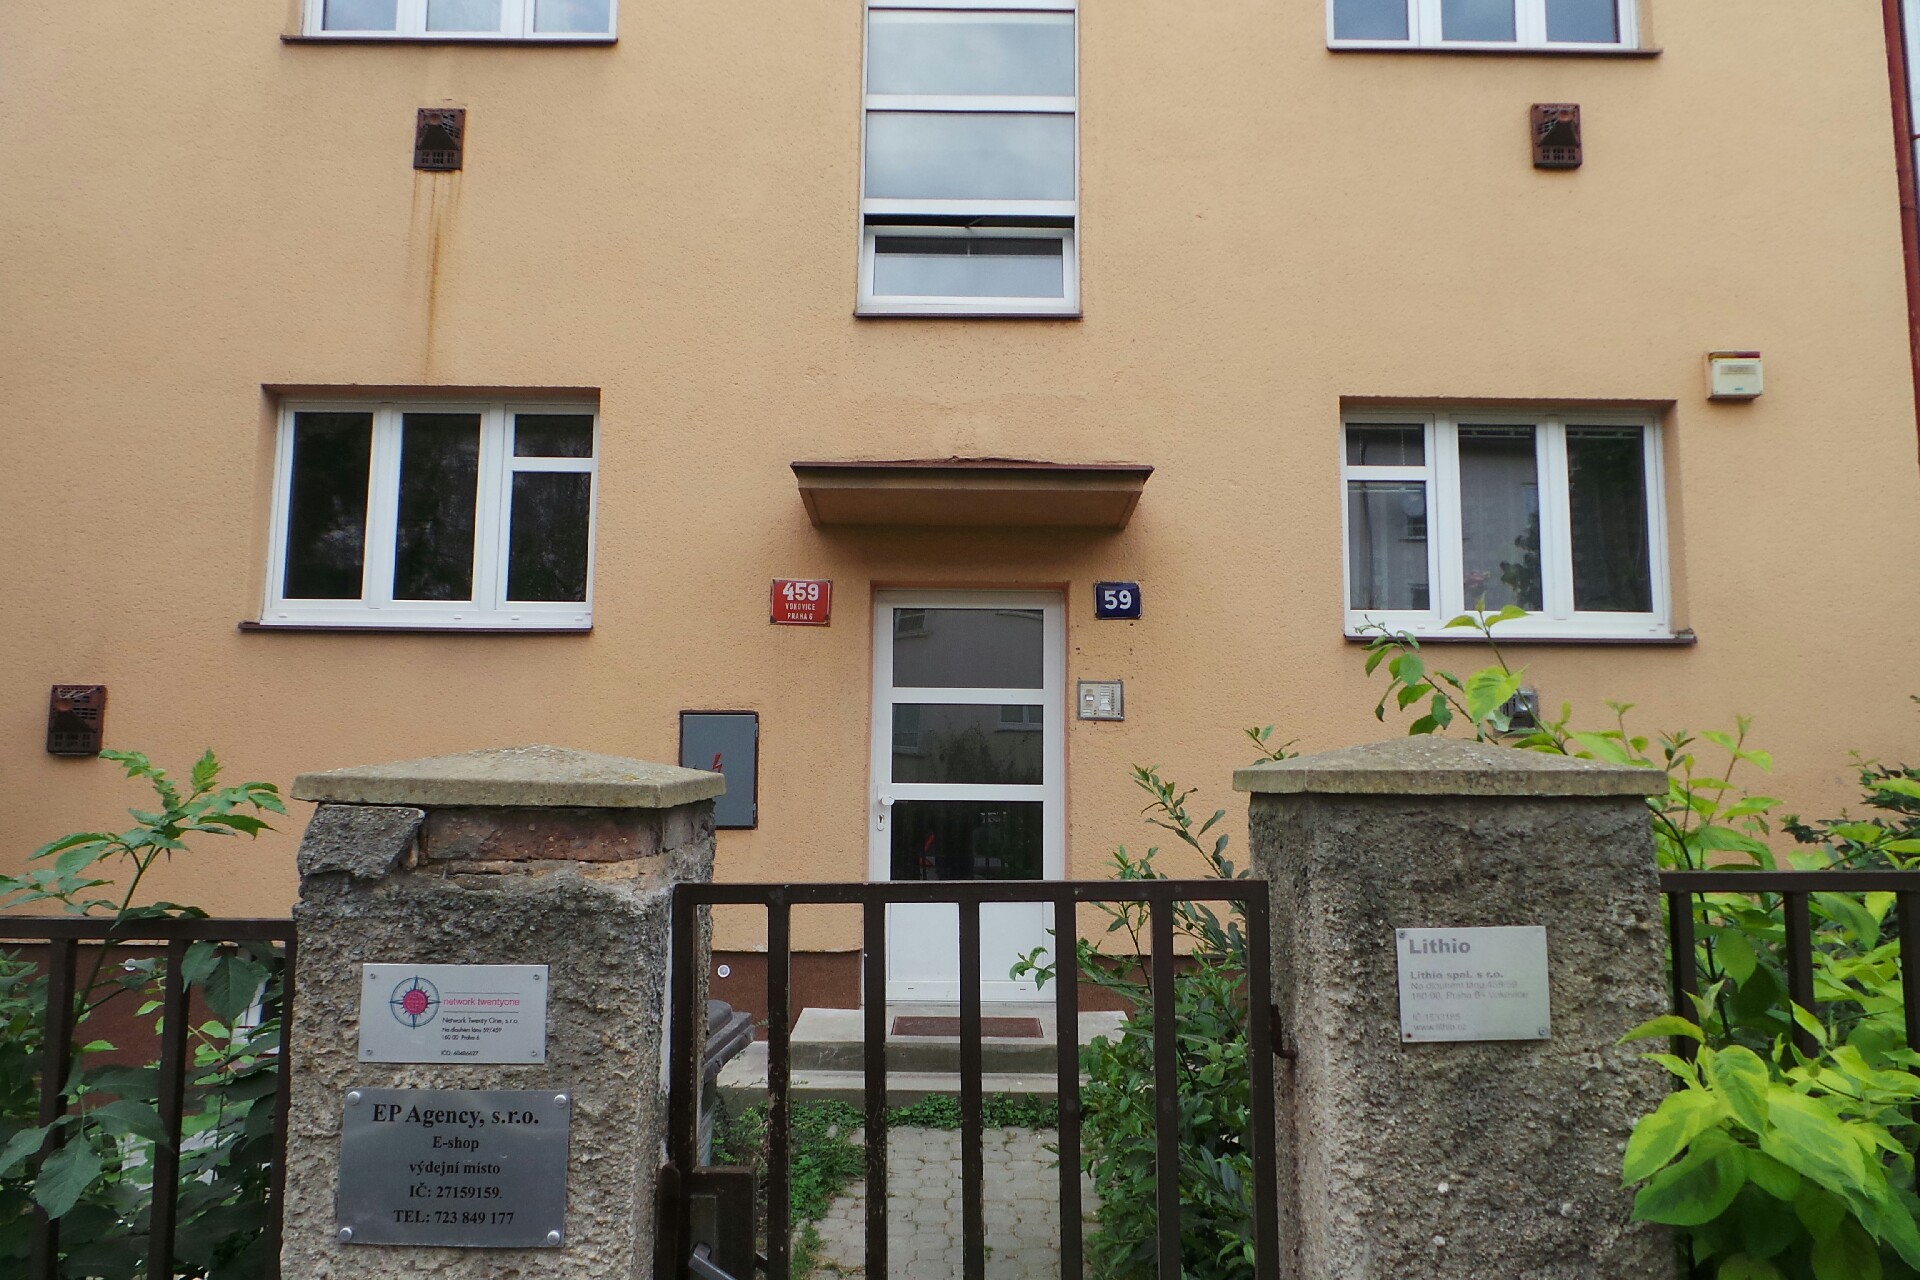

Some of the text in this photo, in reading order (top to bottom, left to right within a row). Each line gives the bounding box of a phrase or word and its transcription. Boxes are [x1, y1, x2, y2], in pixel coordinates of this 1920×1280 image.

[782, 582, 819, 601] 459
[1104, 589, 1132, 610] 59
[785, 602, 816, 611] VOKOVICE
[787, 612, 808, 620] PRAHA
[1409, 938, 1471, 954] Lithio
[1410, 971, 1443, 980] Lithio
[443, 998, 520, 1008] network twentyone
[468, 1017, 488, 1025] Twenty
[488, 1017, 504, 1025] One,
[372, 1103, 540, 1128] EP Agency, s.r.o.
[432, 1135, 480, 1151] E-shop
[409, 1160, 500, 1176] výdejní místo
[409, 1182, 502, 1199] IČ: 27159159.
[393, 1209, 514, 1225] TEL: 723 849 177
